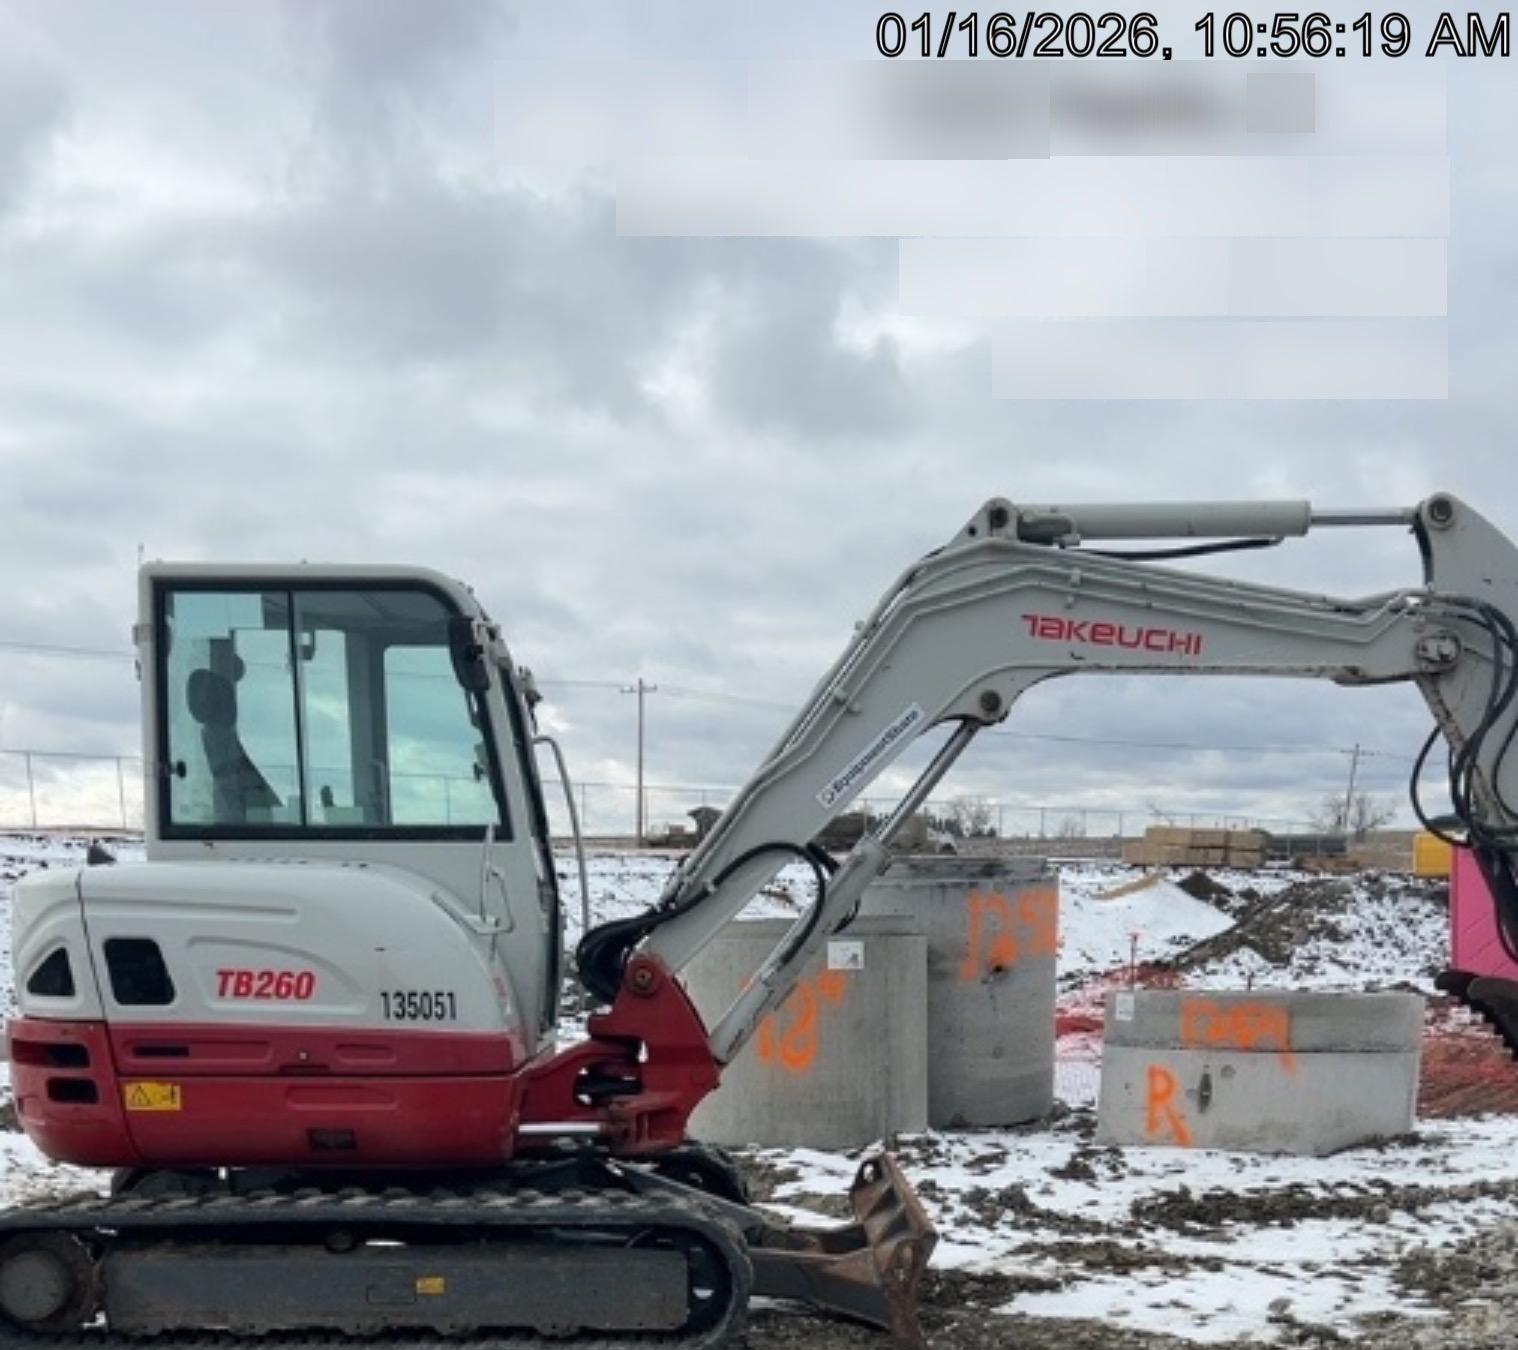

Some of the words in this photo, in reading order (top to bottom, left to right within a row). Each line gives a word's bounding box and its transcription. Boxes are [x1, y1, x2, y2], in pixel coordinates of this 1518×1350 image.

[216, 970, 316, 1000] TB260
[380, 991, 457, 1021] 135051
[1146, 1065, 1193, 1148] R
